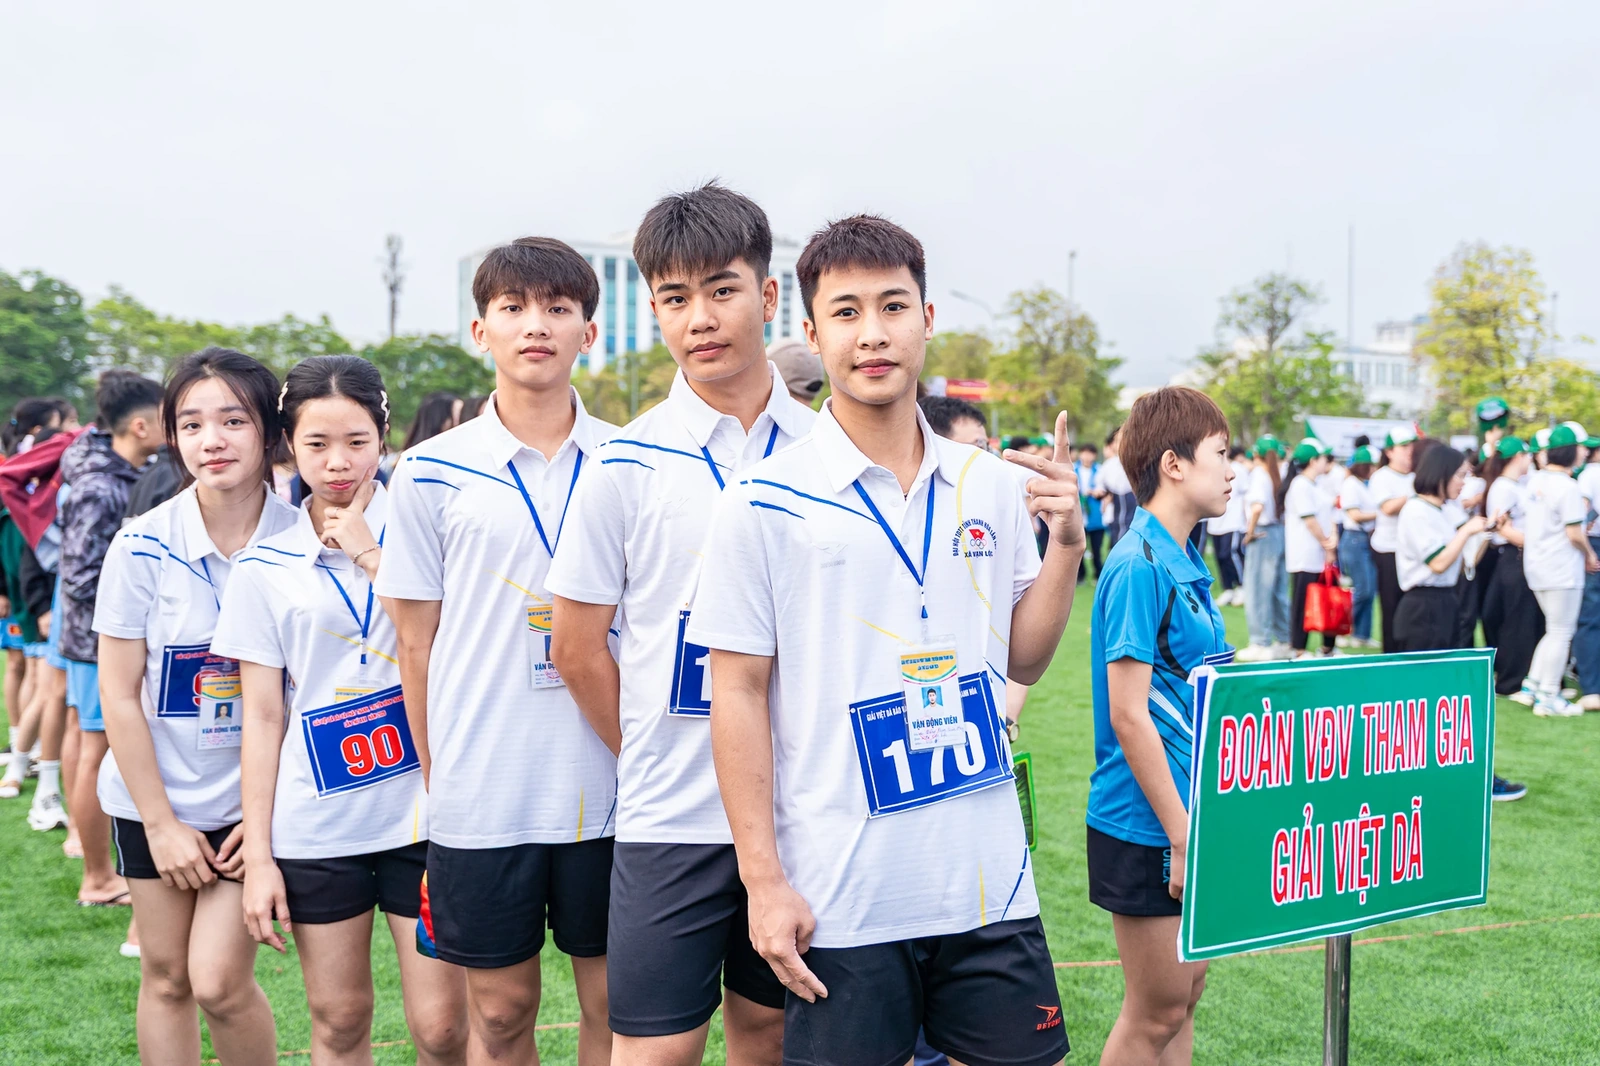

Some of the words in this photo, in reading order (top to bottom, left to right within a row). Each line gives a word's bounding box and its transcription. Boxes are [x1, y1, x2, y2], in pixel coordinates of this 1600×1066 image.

[340, 724, 404, 777] 90
[882, 722, 986, 794] 170
[912, 720, 925, 730] VẬN
[926, 717, 943, 729] ĐỘNG
[943, 715, 958, 725] VIÊN
[1218, 698, 1294, 794] ĐOÀN
[1303, 704, 1354, 784] VĐV
[1361, 698, 1427, 776] THAM
[1436, 695, 1474, 768] GIA
[1272, 803, 1324, 906] GIẢI
[1333, 803, 1385, 905] VIỆT
[1391, 796, 1424, 884] DÃ
